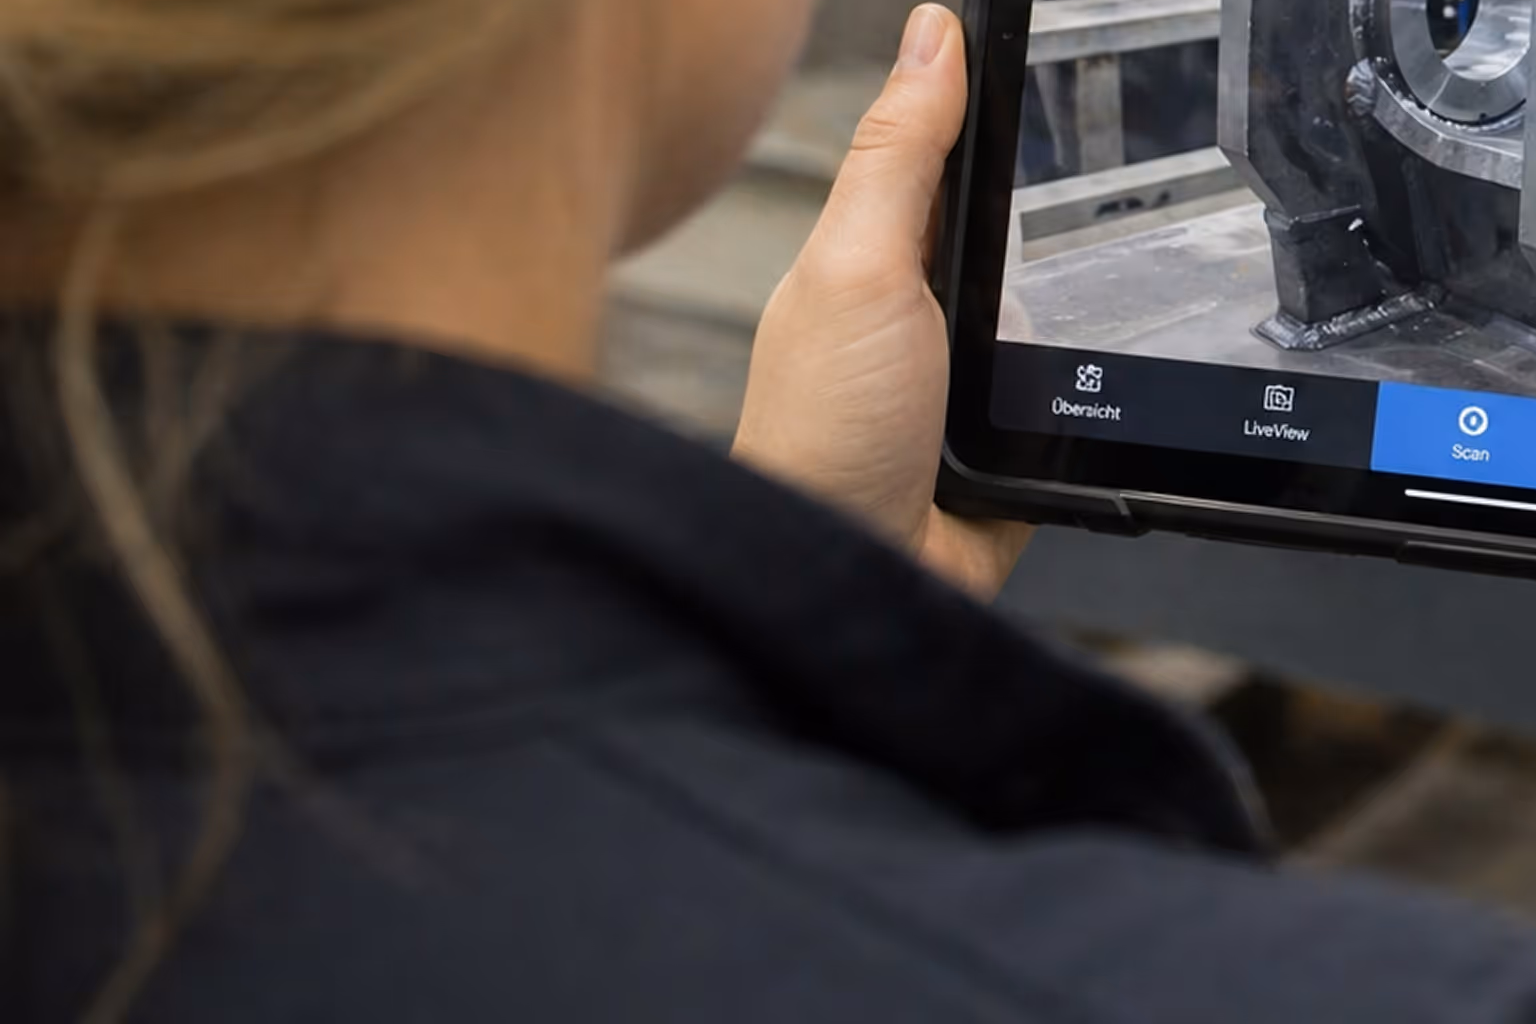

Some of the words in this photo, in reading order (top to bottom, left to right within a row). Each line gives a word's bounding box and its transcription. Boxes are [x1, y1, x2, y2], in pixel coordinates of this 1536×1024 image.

[1051, 396, 1121, 422] Übersicht
[1243, 419, 1310, 442] LiveView
[1451, 443, 1490, 463] Scan
